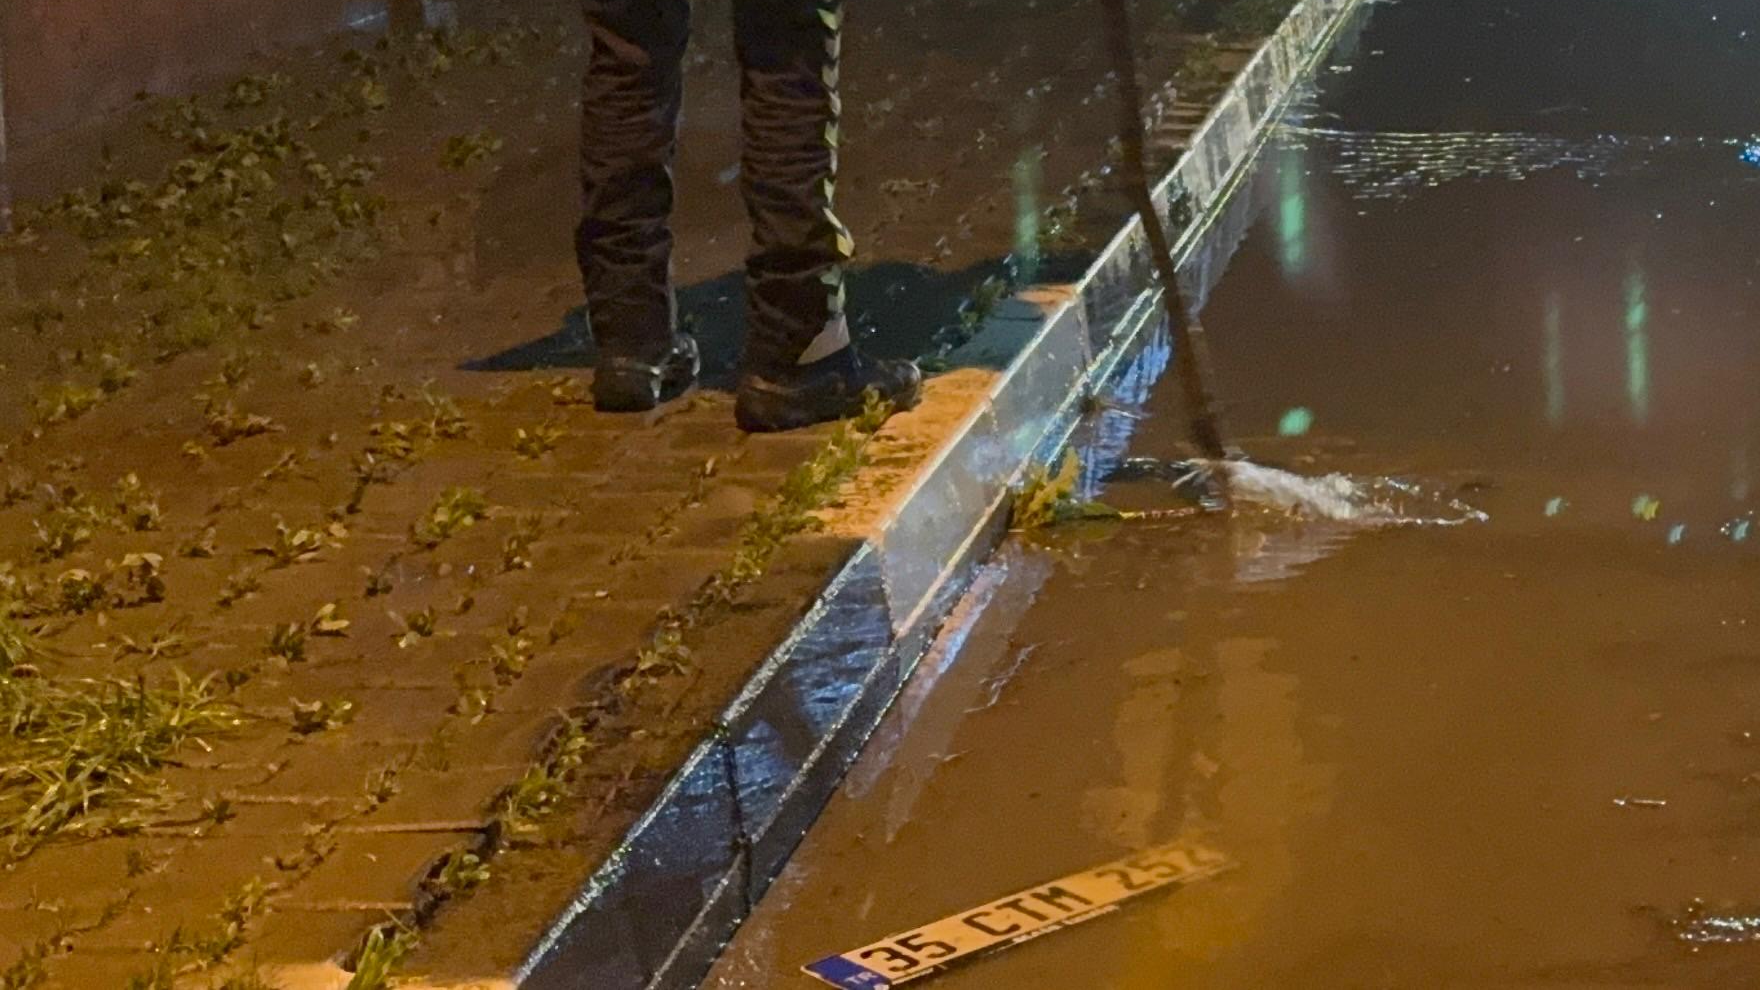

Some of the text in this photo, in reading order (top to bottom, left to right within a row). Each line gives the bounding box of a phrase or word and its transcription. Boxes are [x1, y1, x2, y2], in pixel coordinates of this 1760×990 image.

[860, 932, 957, 973] 35
[962, 882, 1094, 937] CTM
[844, 970, 879, 985] TR
